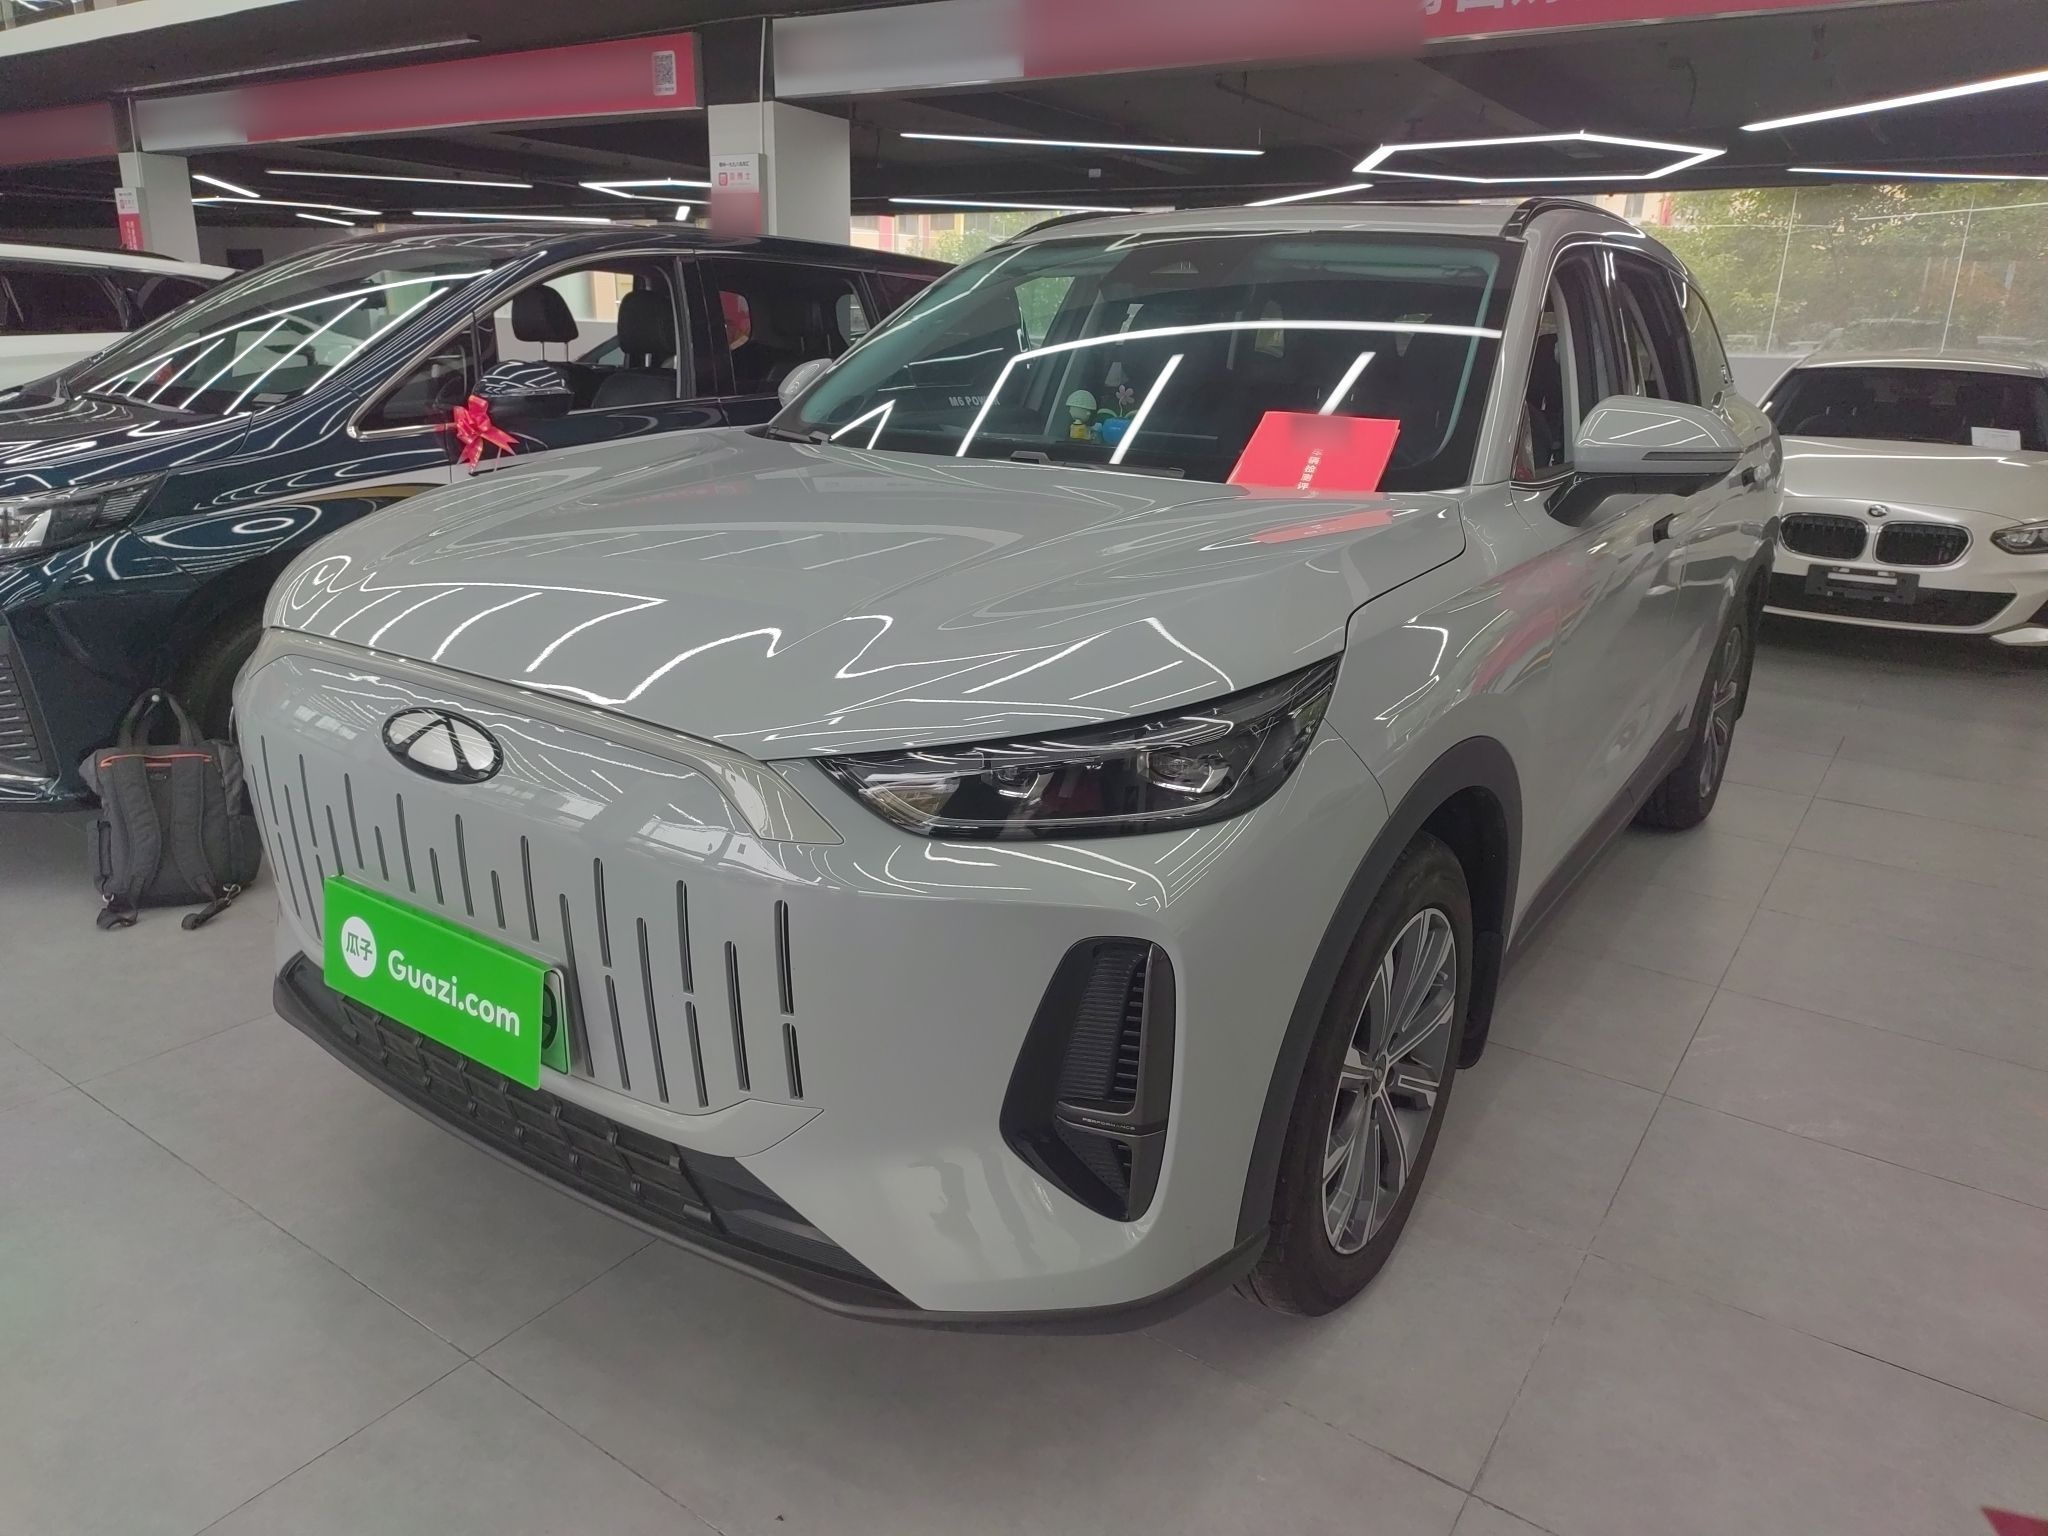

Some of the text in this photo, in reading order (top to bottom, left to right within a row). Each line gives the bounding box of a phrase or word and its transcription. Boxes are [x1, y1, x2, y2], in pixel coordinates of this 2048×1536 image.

[345, 931, 373, 961] 瓜子
[387, 949, 520, 1037] Guazi.com
[1082, 1117, 1136, 1131] PERFORMANCE
